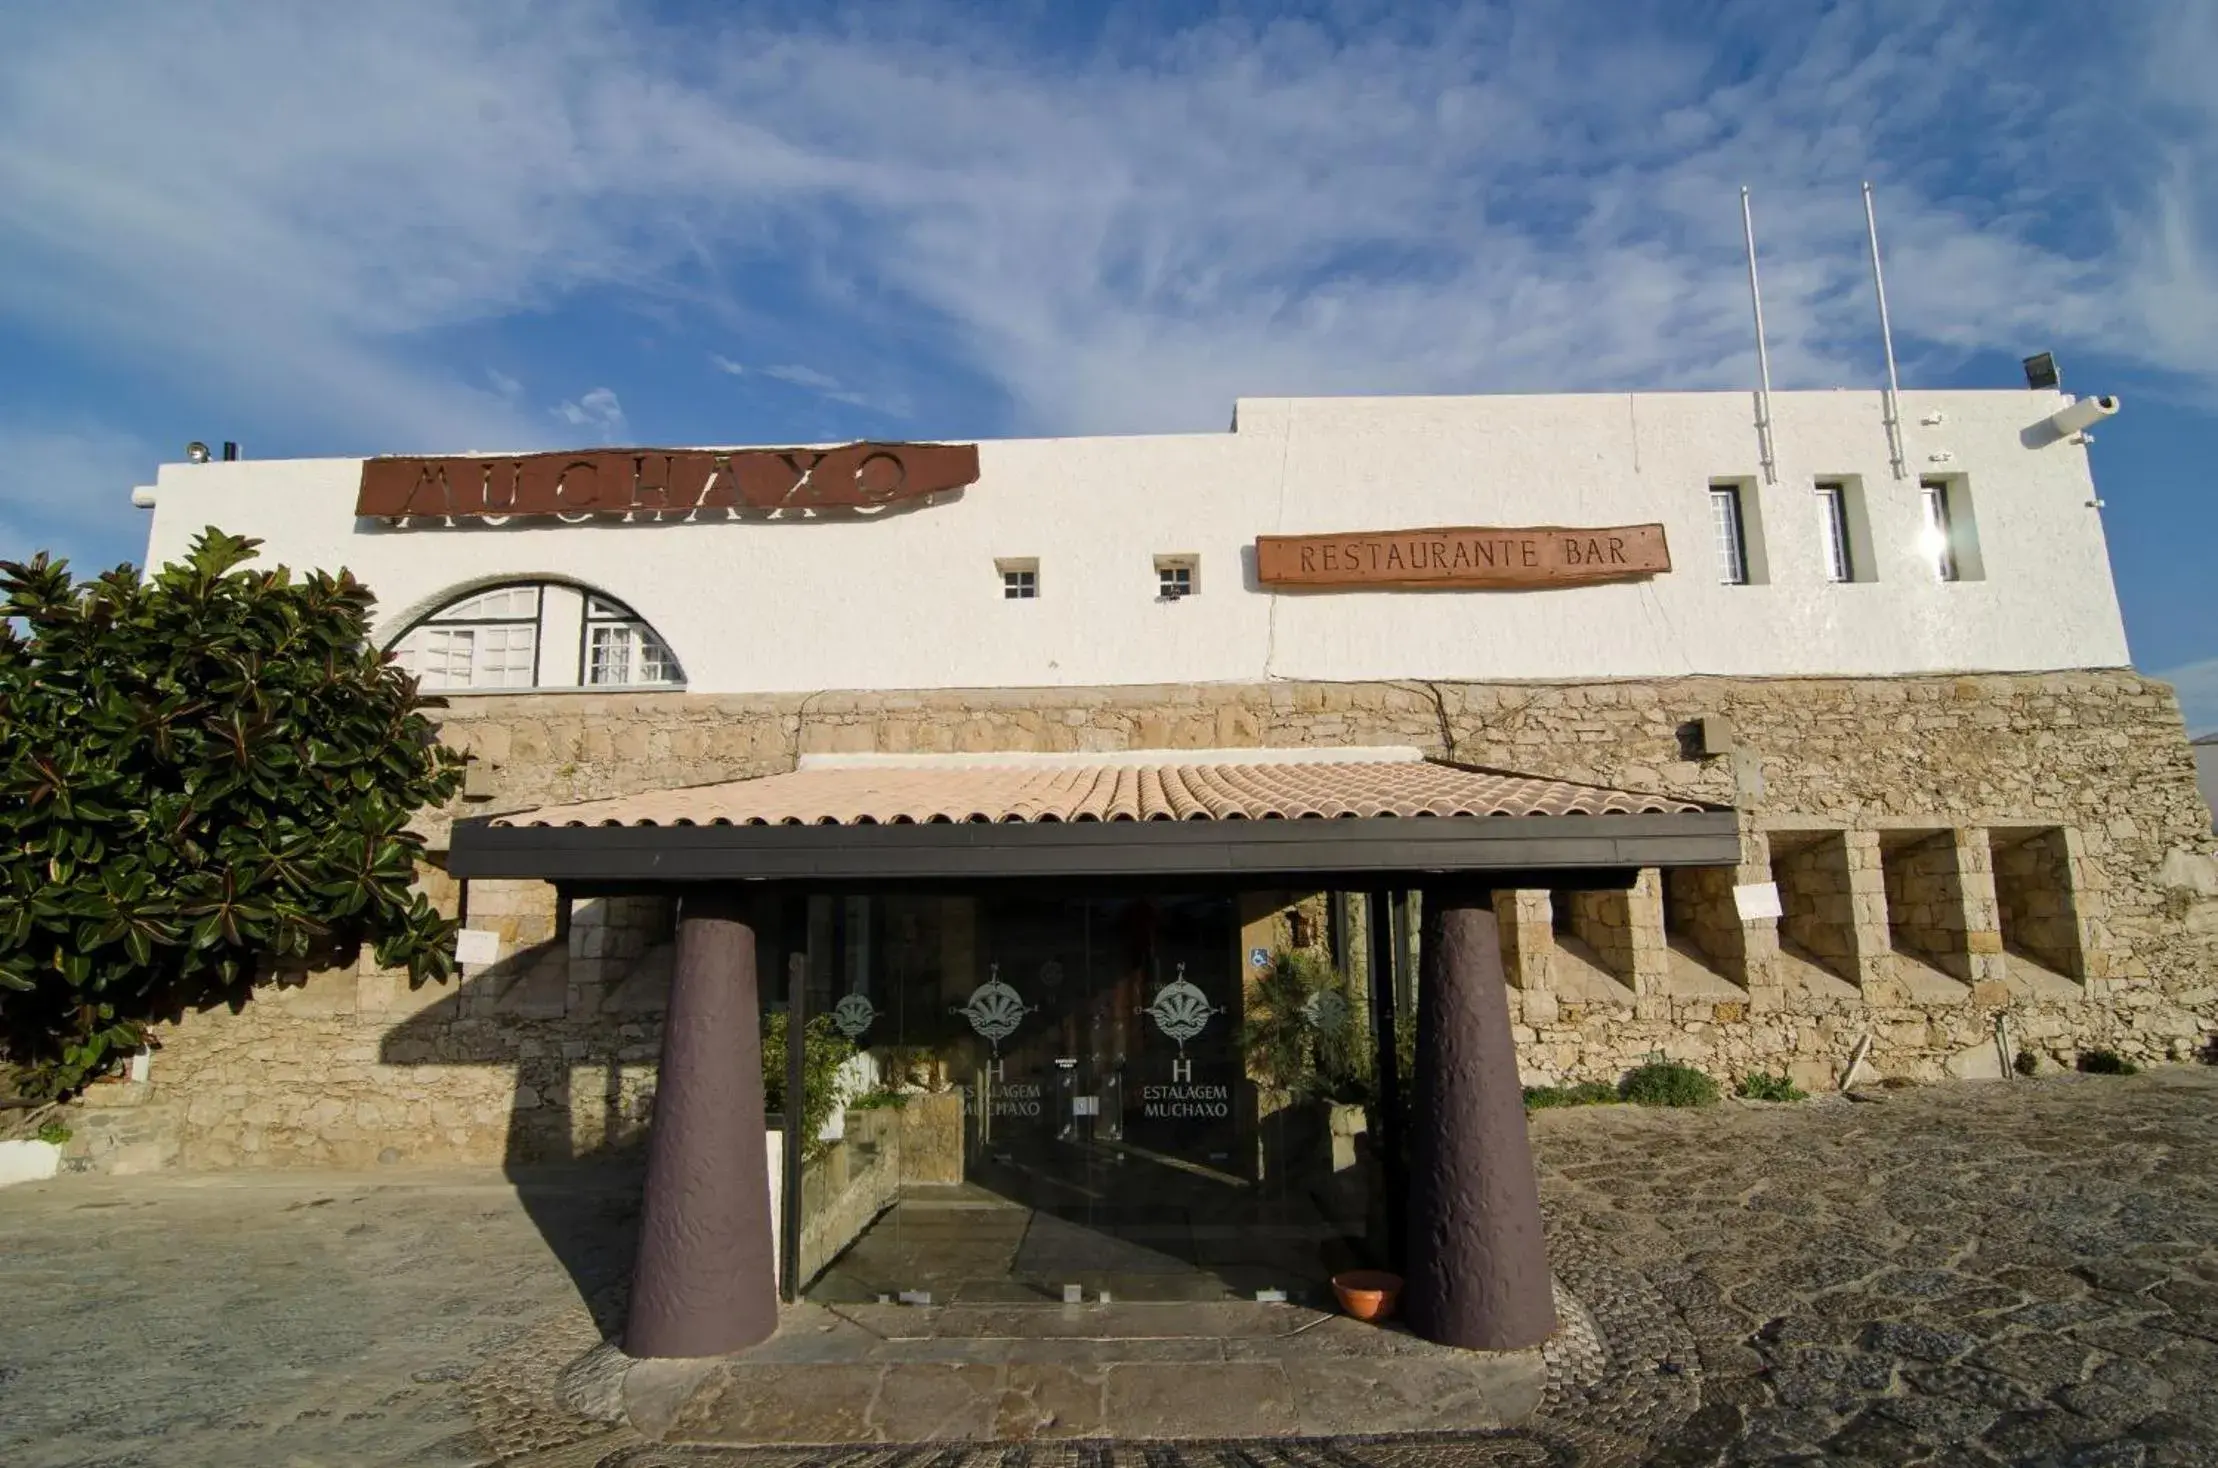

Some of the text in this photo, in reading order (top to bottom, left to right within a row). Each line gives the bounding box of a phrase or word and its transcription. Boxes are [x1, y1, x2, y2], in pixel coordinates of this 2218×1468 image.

[400, 452, 907, 520] MUCHAXO
[1301, 538, 1625, 572] RESTAURANTE BAR
[1172, 1059, 1191, 1082] H
[957, 1084, 1040, 1098] SLAGEM
[1143, 1086, 1228, 1099] ESTALAGEM
[1144, 1103, 1228, 1117] MUCHAXO
